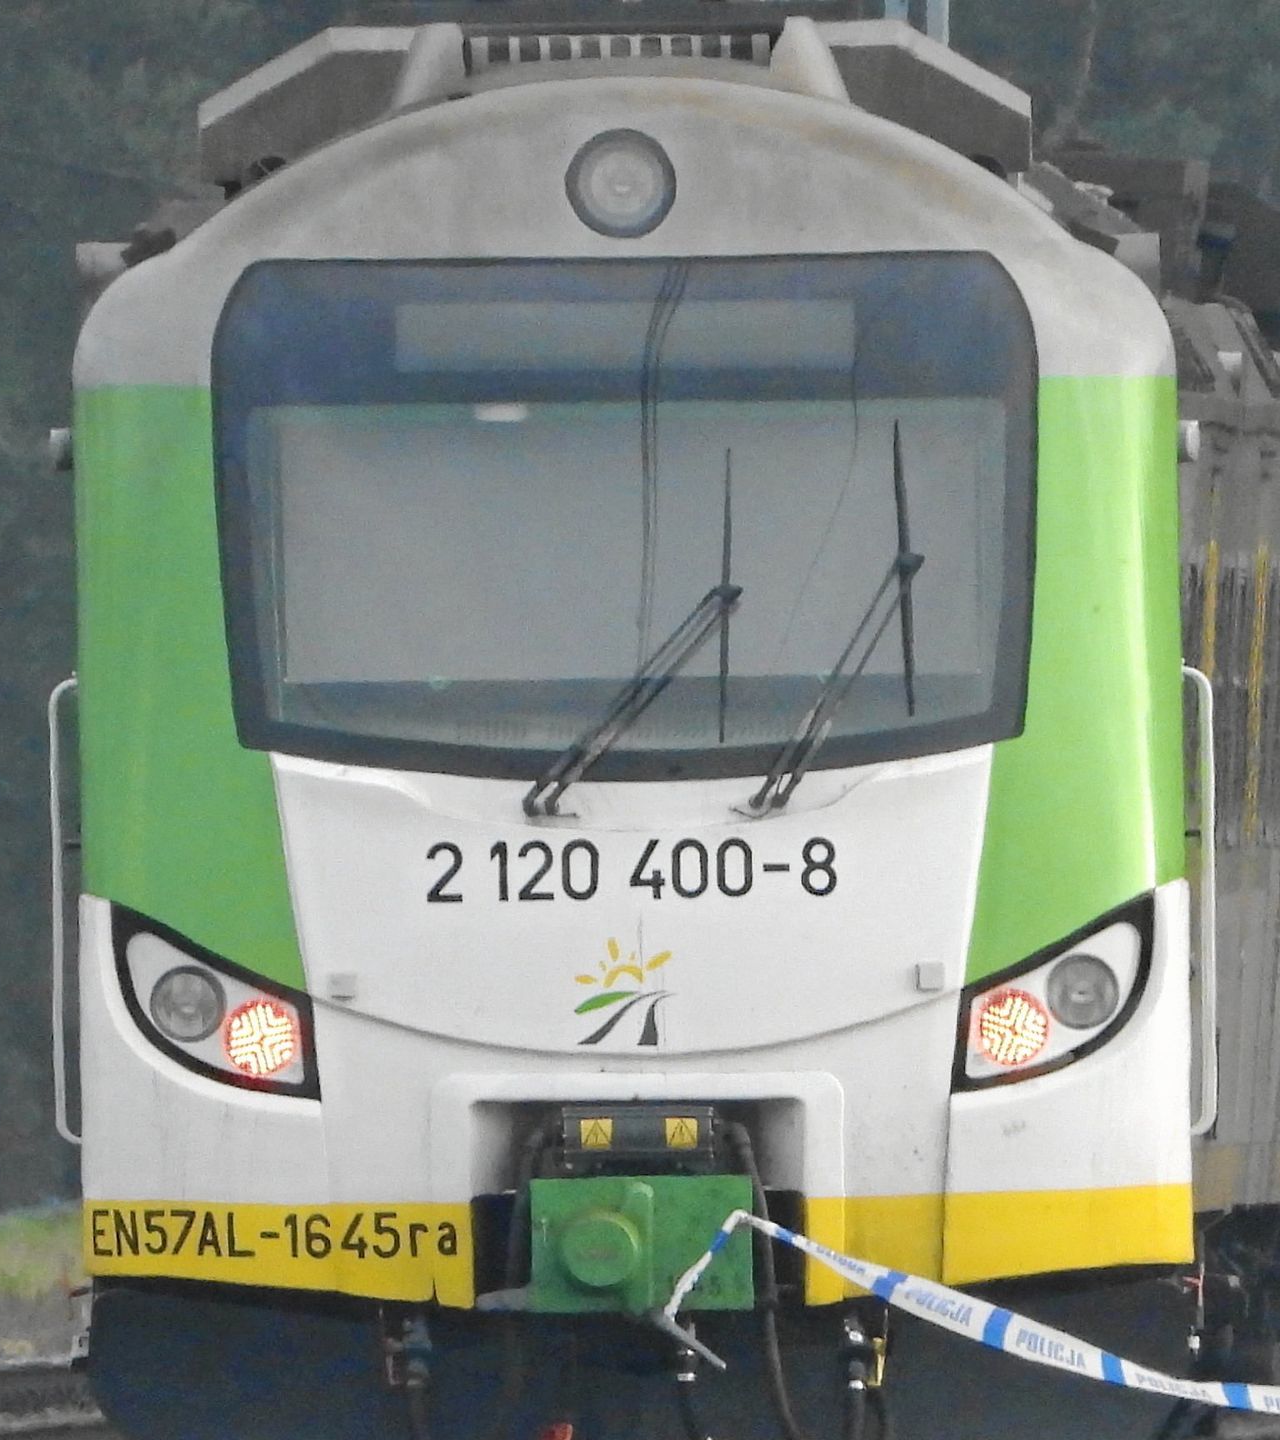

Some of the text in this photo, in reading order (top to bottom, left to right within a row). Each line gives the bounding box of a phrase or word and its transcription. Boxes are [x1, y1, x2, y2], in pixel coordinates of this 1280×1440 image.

[426, 836, 838, 902] 2 120 400-8
[92, 1209, 459, 1259] EN57AL-1645ra
[1016, 1328, 1087, 1369] POLICJA
